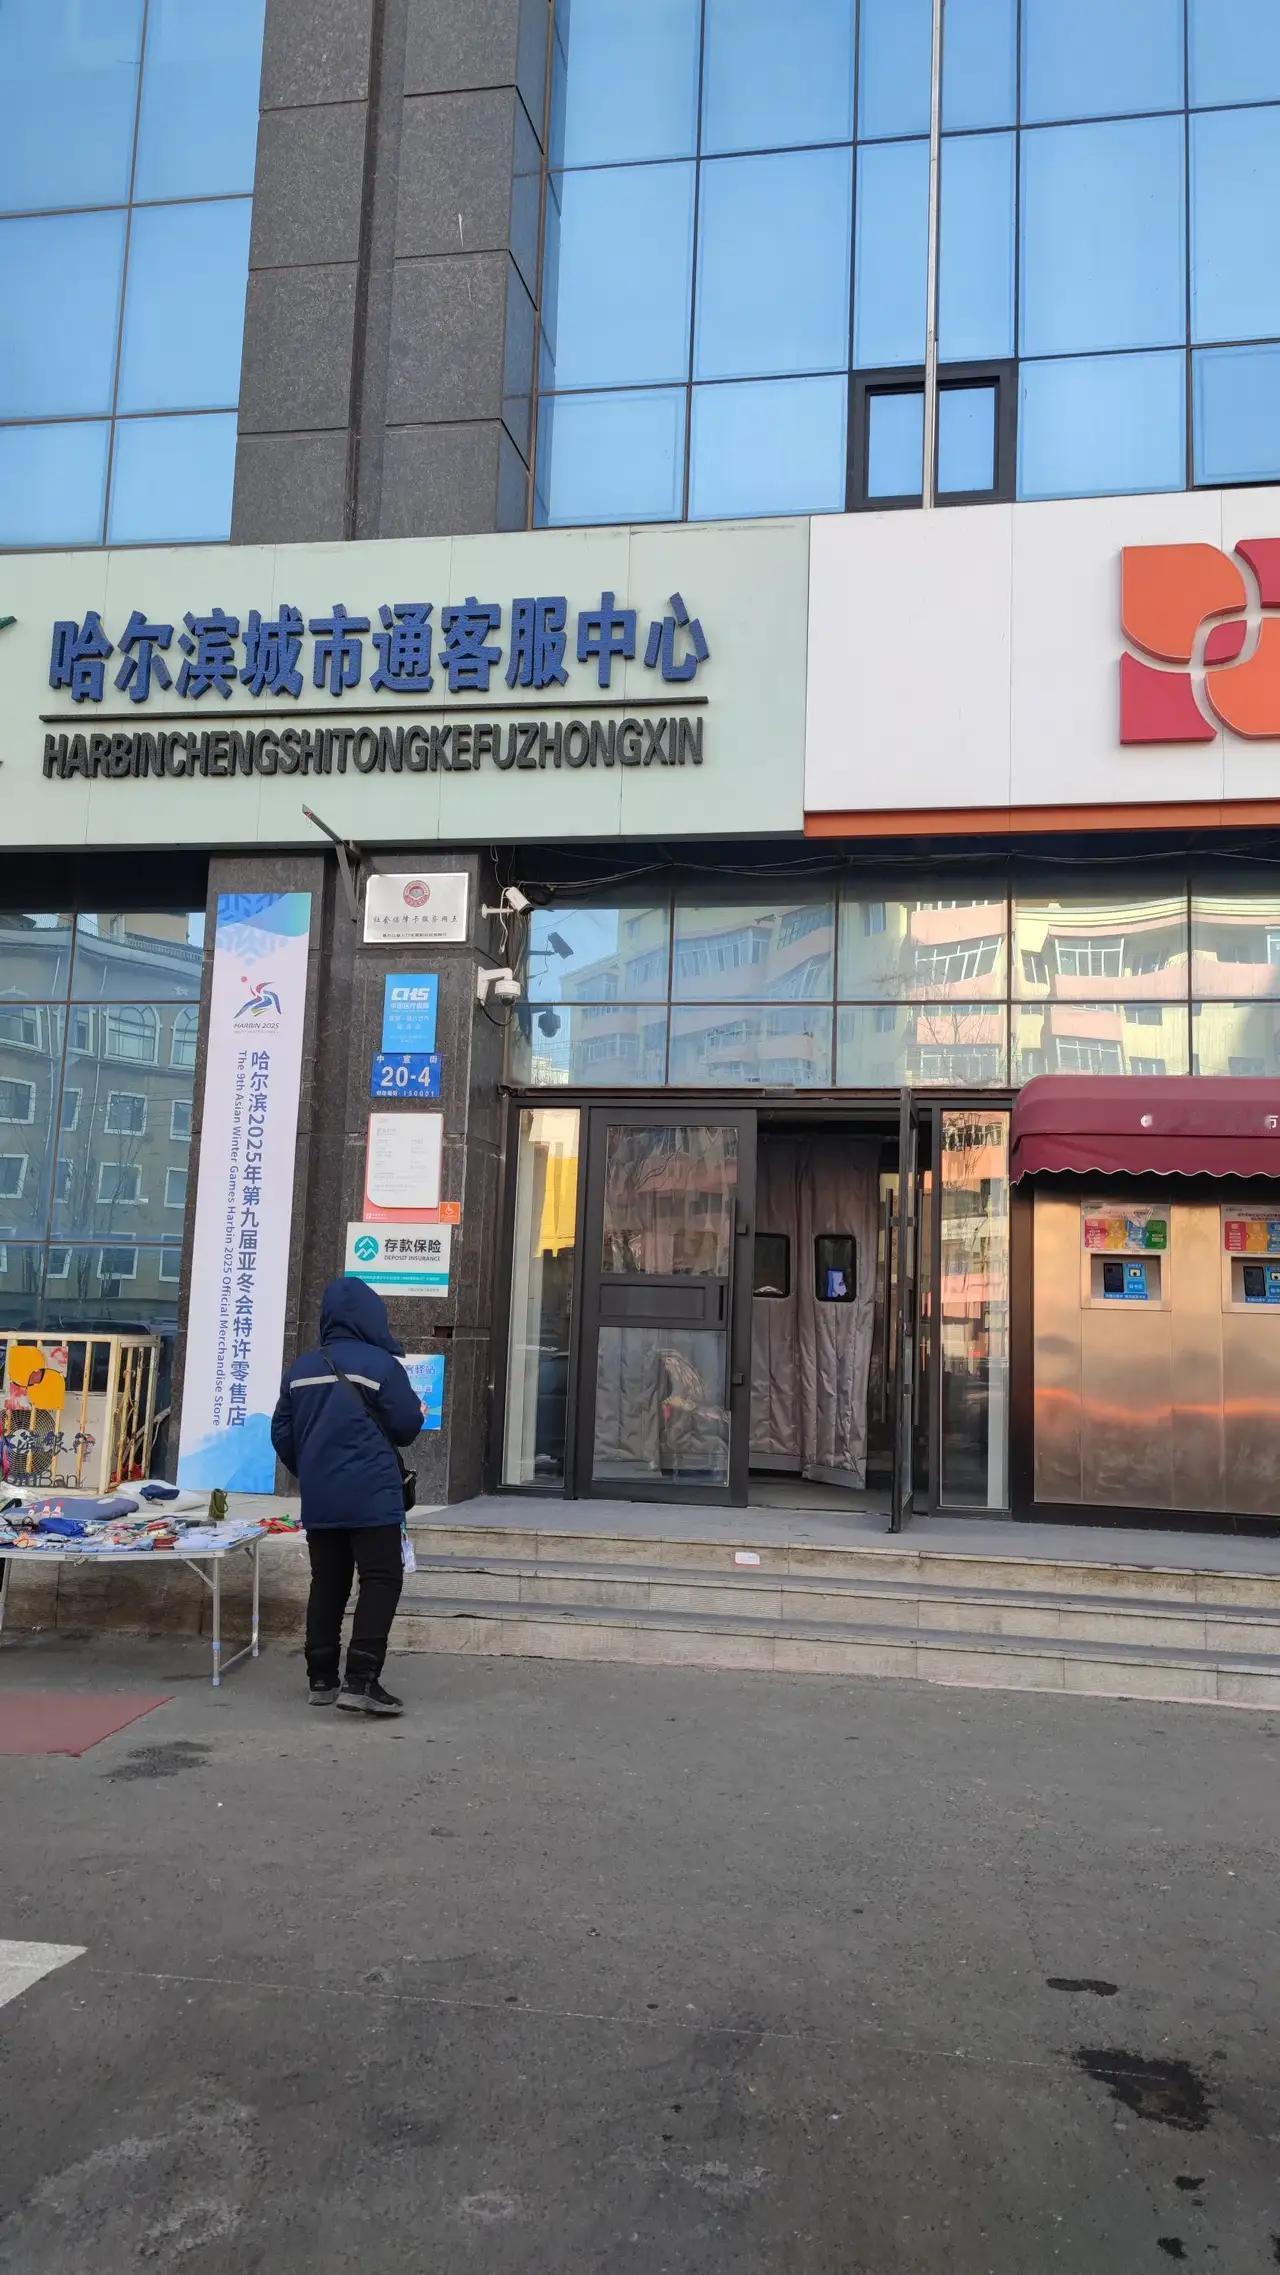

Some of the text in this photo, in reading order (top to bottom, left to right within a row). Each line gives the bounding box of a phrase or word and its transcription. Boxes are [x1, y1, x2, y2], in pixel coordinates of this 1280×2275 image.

[49, 591, 709, 703] 哈尔滨城市通客服中心
[43, 716, 704, 778] HARBINCHENGSHITONGKEFUZHONGXIN
[380, 1066, 431, 1088] 20-4
[212, 1051, 248, 1426] The 9th Asian Winter Games Harbin 2025 Official Merchandise Store
[226, 1050, 270, 1428] 哈尔滨2025年第九届亚冬会特许零售店
[384, 1238, 442, 1253] 存款保险
[408, 1254, 441, 1262] INSURANCE
